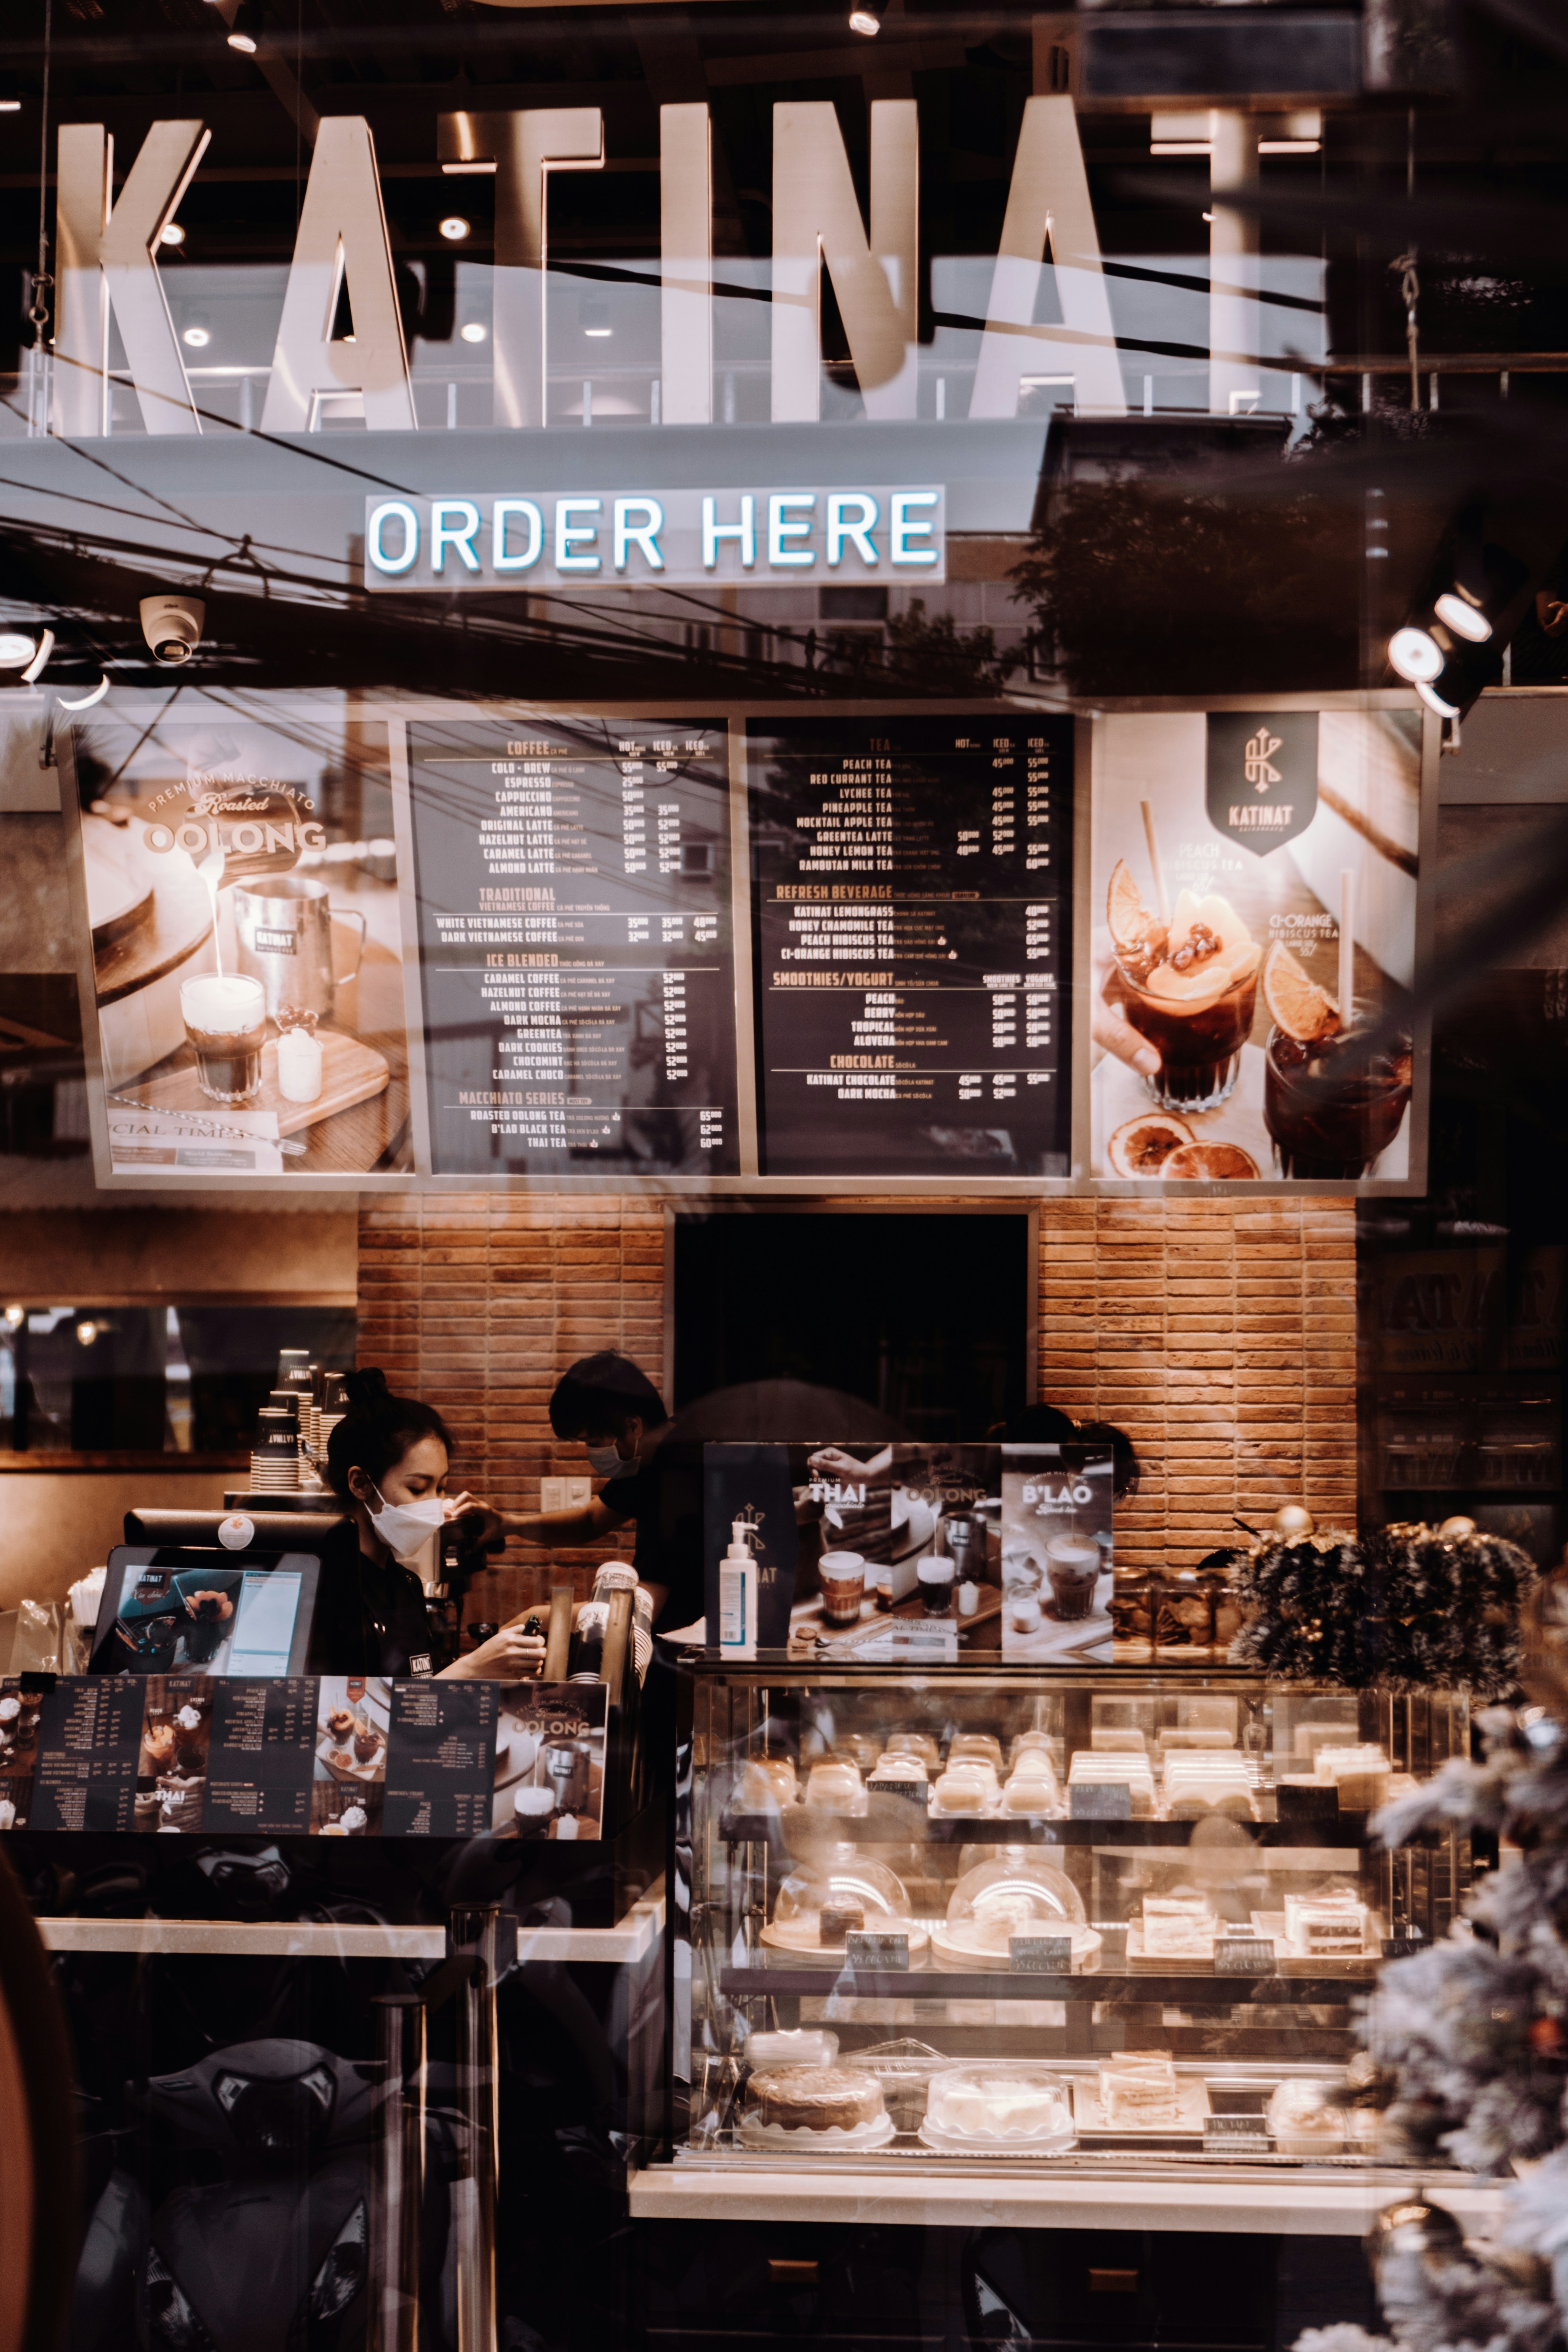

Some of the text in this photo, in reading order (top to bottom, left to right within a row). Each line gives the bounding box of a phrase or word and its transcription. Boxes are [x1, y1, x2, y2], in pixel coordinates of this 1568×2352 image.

[51, 95, 1322, 436] KATINAT
[369, 492, 939, 572] ORDER HERE
[508, 742, 549, 755] COFFEE
[619, 741, 635, 751] HOT
[653, 741, 671, 751] ICED
[686, 741, 704, 751] ICED
[870, 739, 890, 751] TEA
[955, 739, 970, 748] HOT
[993, 739, 1009, 748] ICED
[1028, 739, 1044, 748] ICED
[492, 763, 515, 773] COLD
[524, 763, 550, 773] BREW
[843, 759, 892, 770] PEACH TEA
[505, 777, 551, 788] ESPRESSO
[810, 774, 892, 784] RED CURRANT TEA
[148, 772, 315, 812] PREMIUM MACCHIATO
[496, 792, 552, 802] CAPPUCCINO
[840, 789, 892, 799] LYCHEE TEA
[195, 792, 269, 815] Roasted
[823, 803, 892, 813] PINEAPPLE TEA
[500, 806, 553, 816] AMERICANO
[1229, 805, 1293, 826] KATINAT
[481, 820, 553, 831] ORIGINAL LATTE
[797, 817, 892, 828] MOCKTAIL APPLE TEA
[143, 822, 327, 854] OOLONG
[479, 834, 553, 845] HAZELNUT LATTE
[817, 831, 892, 842] GREENTEA LATTE
[484, 848, 554, 859] CARAMEL LATTE
[810, 845, 892, 856] HONEY LEMON TEA
[1179, 843, 1220, 858] PEACH
[489, 863, 555, 873] ALMOND LATTE
[799, 860, 892, 871] RAMBUTAN MILK TEA
[1221, 860, 1242, 871] TEA
[479, 888, 555, 901] TRADITIONAL
[776, 885, 892, 899] REFRESH BEVERAGE
[479, 902, 555, 911] VIETNAMESE COFFEE
[794, 906, 894, 917] KATINAT LEMONGRASS
[437, 918, 557, 928] WHITE VIETNAMESE COFFEE
[790, 920, 894, 931] HONEY CHAMOMILE TEA
[1269, 914, 1332, 928] CI-ORANGE
[441, 932, 557, 942] DARK VIETNAMESE COFFEE
[1269, 929, 1339, 938] HIBISCUS TEA
[801, 934, 894, 945] PEACH HIBISCUS TEA
[781, 949, 894, 960] CI-ORANGE HIBISCUS TEA
[487, 954, 558, 967] ICE BLENDED
[485, 974, 560, 984] CARAMEL COFFEE
[773, 972, 894, 986] SMOOTHIES/YOGURT
[983, 975, 1021, 983] SMOOTHIES
[1026, 974, 1053, 983] YOGURT
[481, 988, 560, 997] HAZELNUT COFFEE
[865, 994, 895, 1004] PEACH
[490, 1002, 561, 1011] ALMOND COFFEE
[864, 1007, 895, 1018] BERRY
[504, 1015, 561, 1025] DARK MOCHA
[851, 1021, 895, 1032] TROPICAL
[517, 1029, 562, 1039] GREENTEA
[854, 1035, 895, 1046] ALOVERA
[498, 1043, 562, 1053] DARK COOKIES
[513, 1057, 563, 1066] CHOCOMINT
[830, 1055, 894, 1068] CHOCOLATE
[493, 1070, 564, 1080] CARAMEL CHOCO
[807, 1074, 896, 1085] KATINAT CHOCOLATE
[459, 1092, 564, 1105] MACCHIATO SERIES
[838, 1089, 896, 1099] DARK MOCHA
[470, 1111, 565, 1121] ROASTED OOLONG TEA
[492, 1124, 566, 1134] B'LAO BLACK TEA
[528, 1138, 566, 1148] THAI TEA
[809, 1483, 865, 1502] THAI
[906, 1488, 987, 1502] OOLONG
[513, 1720, 591, 1735] OOLONG
[155, 1790, 186, 1801] THAI
